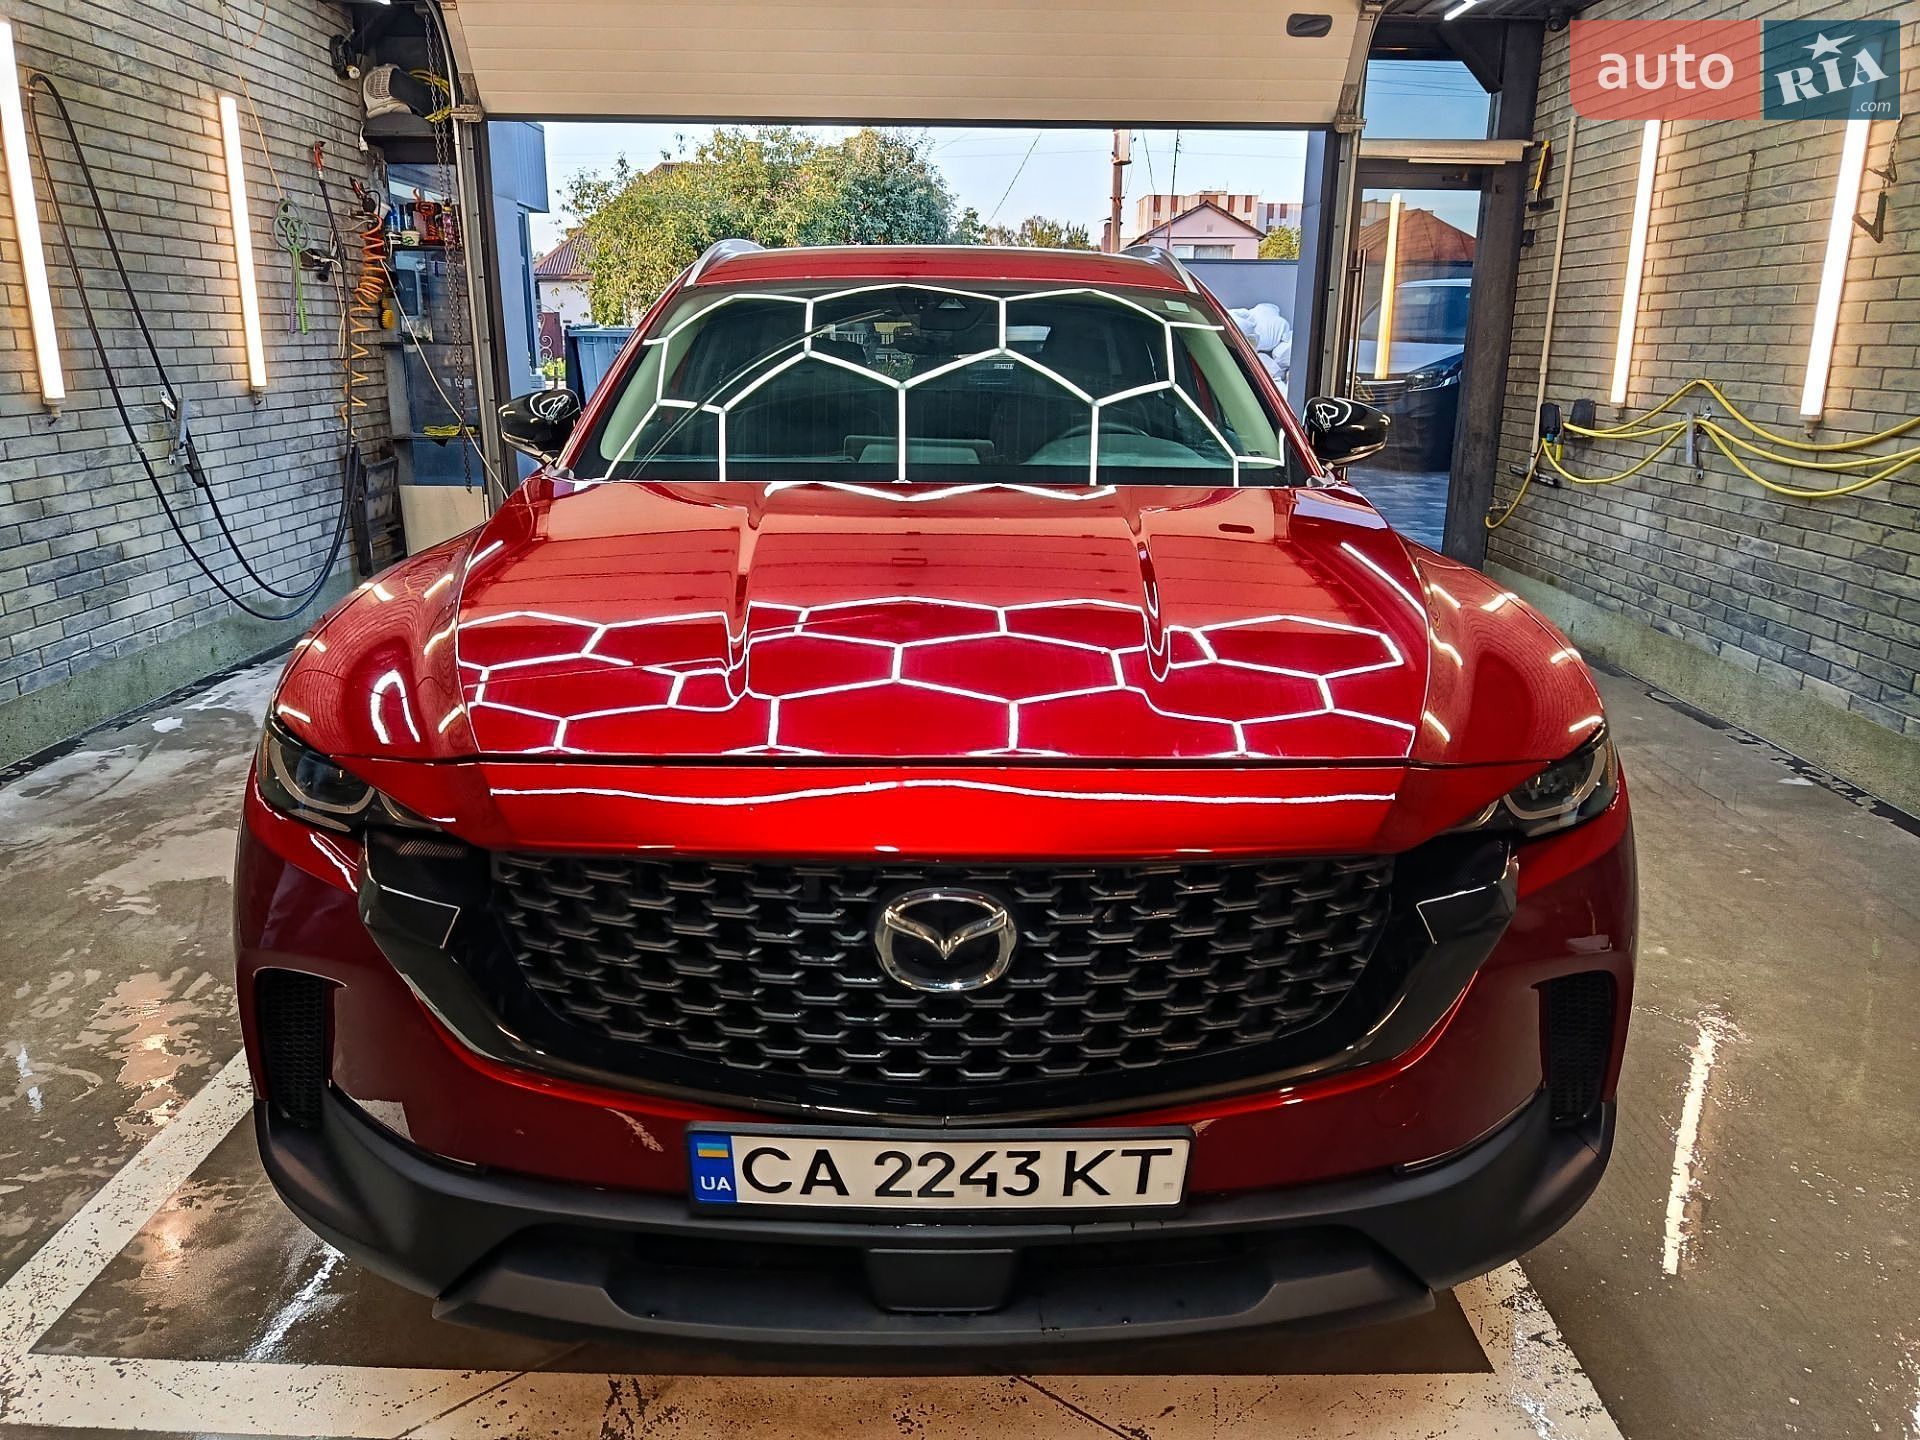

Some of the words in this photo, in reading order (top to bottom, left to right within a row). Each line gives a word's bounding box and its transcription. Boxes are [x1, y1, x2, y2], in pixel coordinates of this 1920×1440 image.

[700, 1175, 732, 1191] UA
[741, 1146, 850, 1197] CA
[873, 1150, 1041, 1199] 2243
[1062, 1147, 1173, 1197] KT
